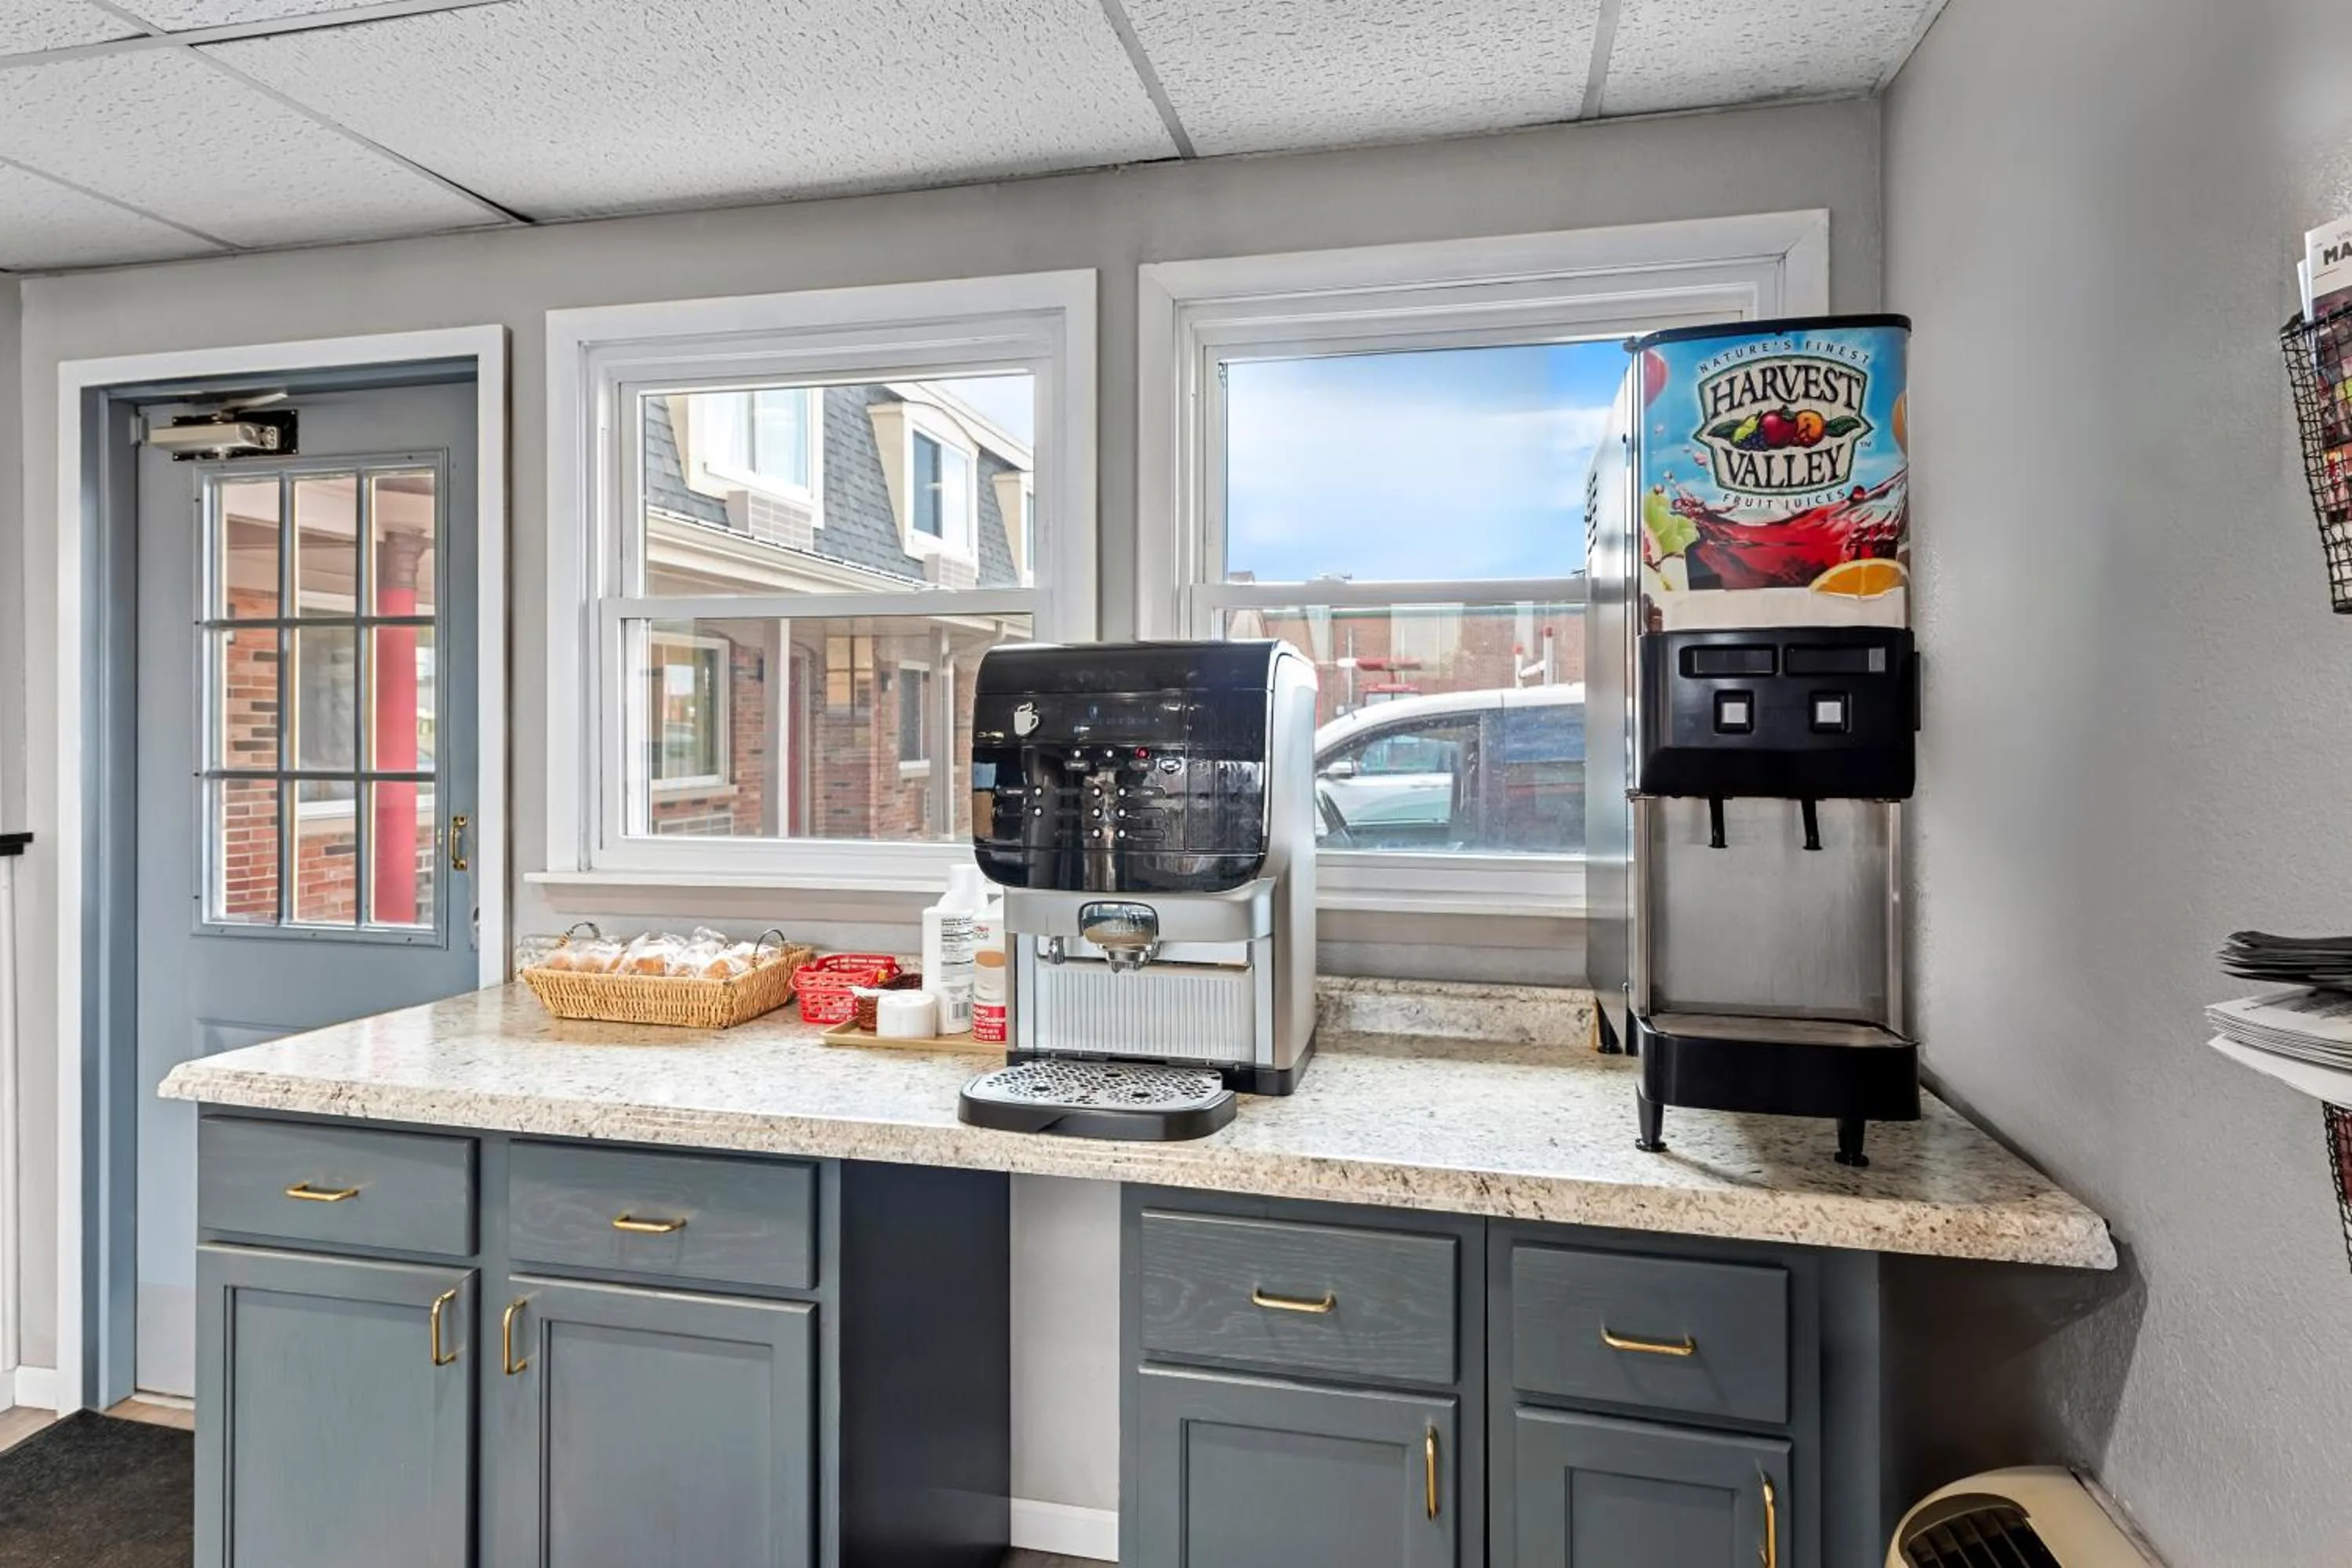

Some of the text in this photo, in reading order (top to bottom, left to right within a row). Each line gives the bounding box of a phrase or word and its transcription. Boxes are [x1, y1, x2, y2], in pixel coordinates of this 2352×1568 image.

[1700, 340, 1870, 374] NATURE'S FINEST
[1710, 364, 1862, 419] HARVEST
[1720, 444, 1845, 488] VALLEY
[1722, 488, 1846, 509] FRUIT JUICES
